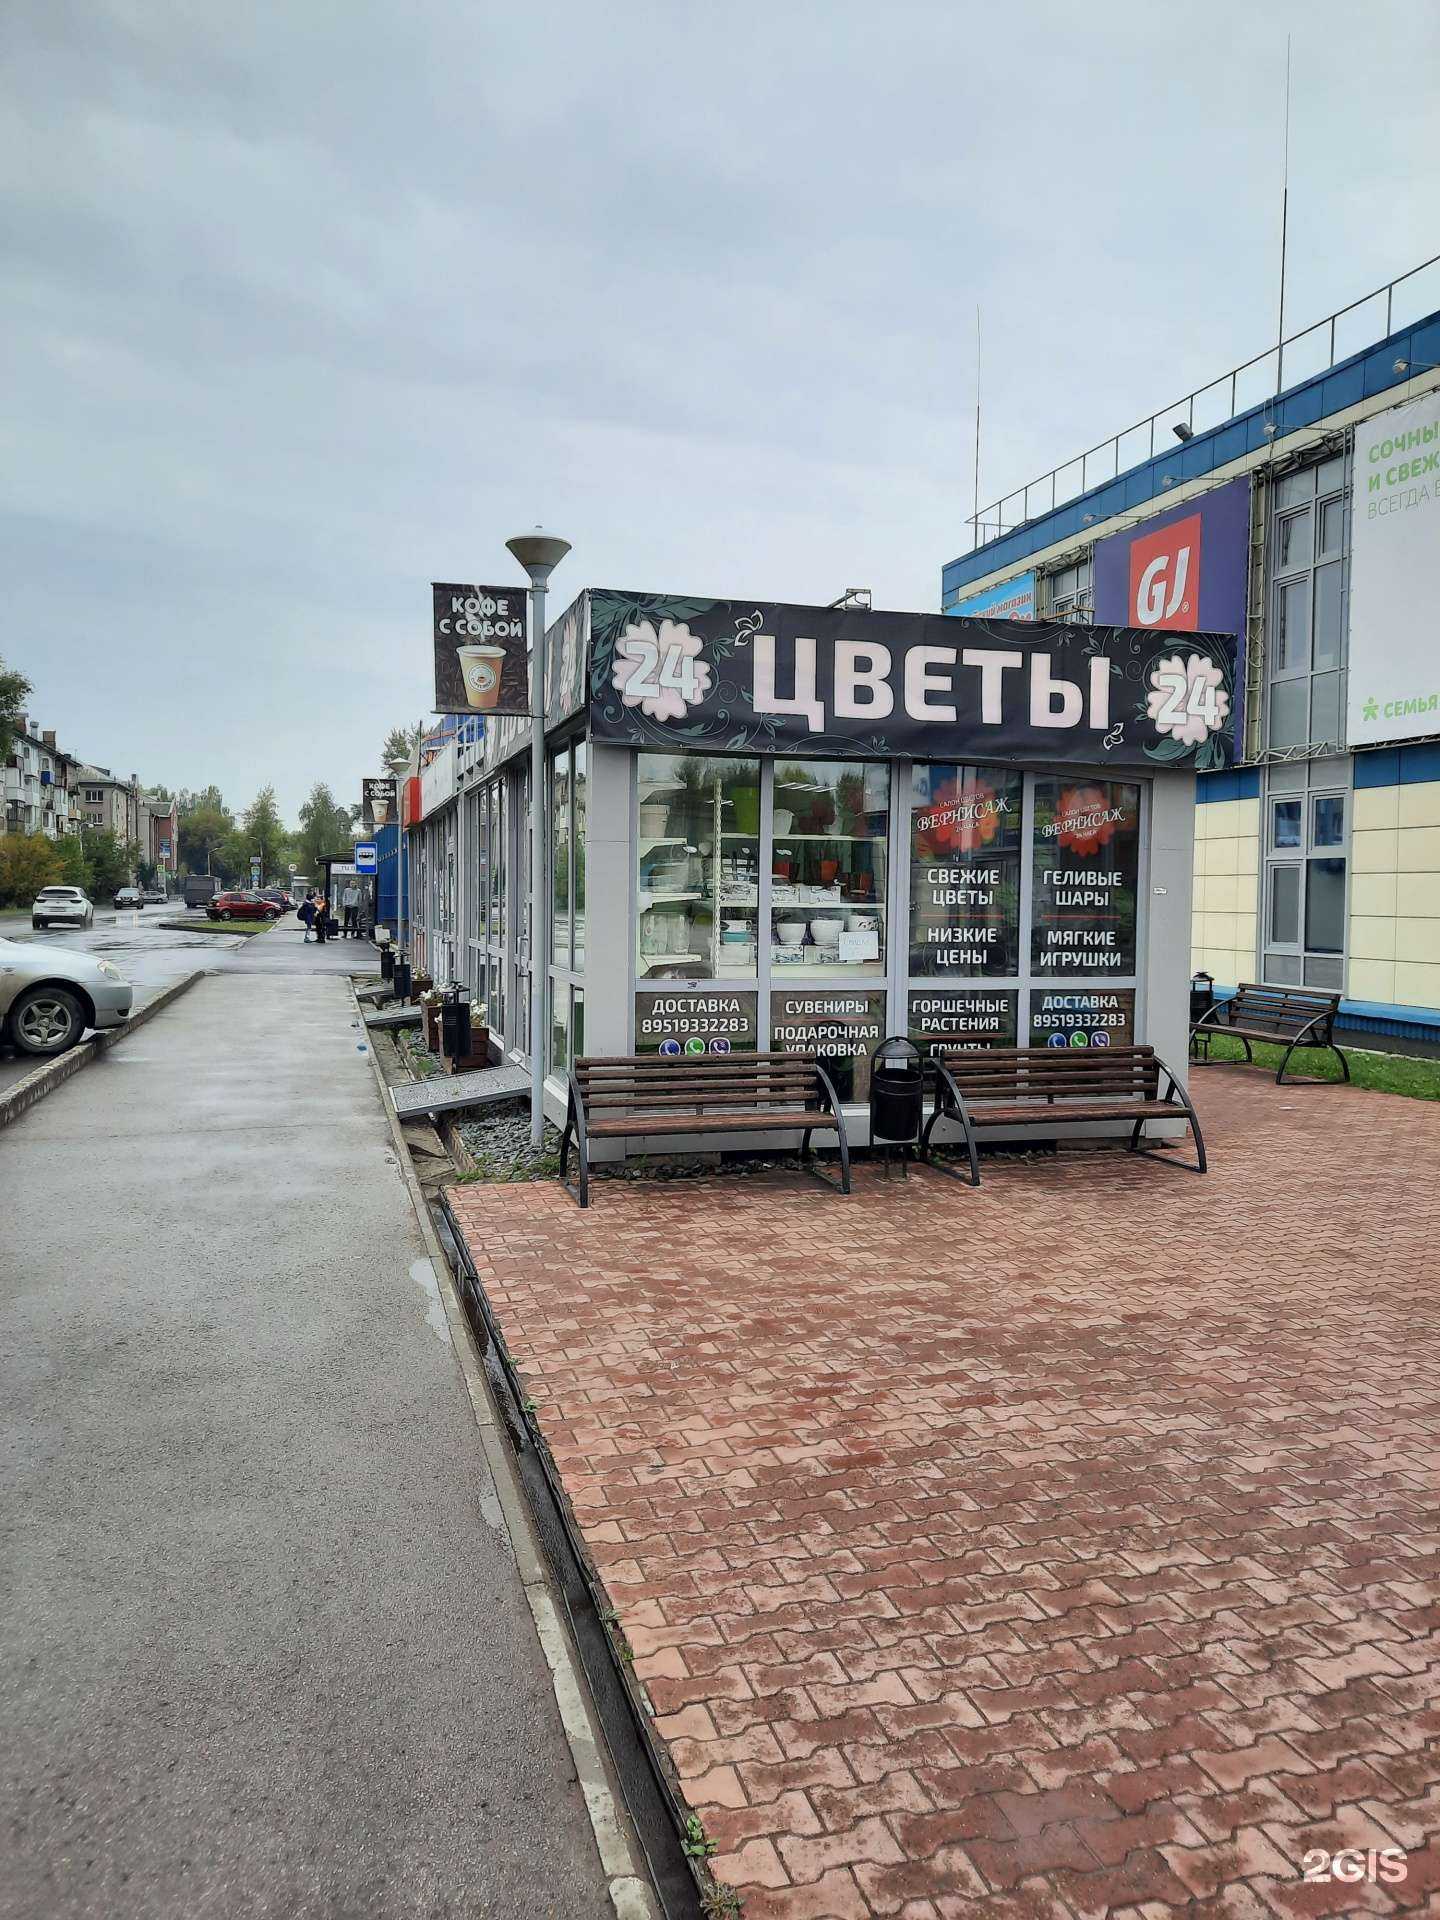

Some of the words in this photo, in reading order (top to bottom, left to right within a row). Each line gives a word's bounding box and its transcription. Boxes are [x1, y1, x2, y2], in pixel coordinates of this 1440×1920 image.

[1368, 473, 1380, 492] И
[1367, 484, 1430, 519] ВСЕГДА
[1136, 546, 1191, 625] GJ
[451, 596, 509, 617] КОФЕ
[439, 618, 451, 634] С
[455, 618, 522, 637] СОБОЙ
[625, 640, 699, 701] 24
[753, 635, 1111, 733] ЦВЕТЫ
[1158, 674, 1219, 726] 24
[1384, 694, 1438, 718] СЕМЬЯ
[916, 797, 1013, 832] ВЕРНИСАЖ
[1041, 807, 1126, 838] ВЕРНИСАЖ
[927, 868, 1000, 885] СВЕЖИЕ
[1043, 870, 1123, 886] ГЕЛИВЫЕ
[932, 890, 993, 907] ЦВЕТЫ
[1055, 891, 1109, 906] ШАРЫ
[927, 928, 997, 943] НИЗКИЕ
[1047, 930, 1116, 946] МЯГКИЕ
[936, 949, 987, 967] ЦЕНЫ
[1040, 951, 1121, 967] ИГРУШКИ
[652, 999, 740, 1015] ДОСТАВКА
[785, 1000, 869, 1014] СУВЕНИРЫ
[912, 999, 1009, 1014] ГОРШЕЧНЫЕ
[1042, 995, 1119, 1011] ДОСТАВКА
[642, 1018, 749, 1033] 89519332283
[921, 1017, 999, 1031] РАСТЕНИЯ
[1033, 1013, 1126, 1028] 89519332283
[775, 1025, 879, 1041] ПОДАРОЧНАЯ
